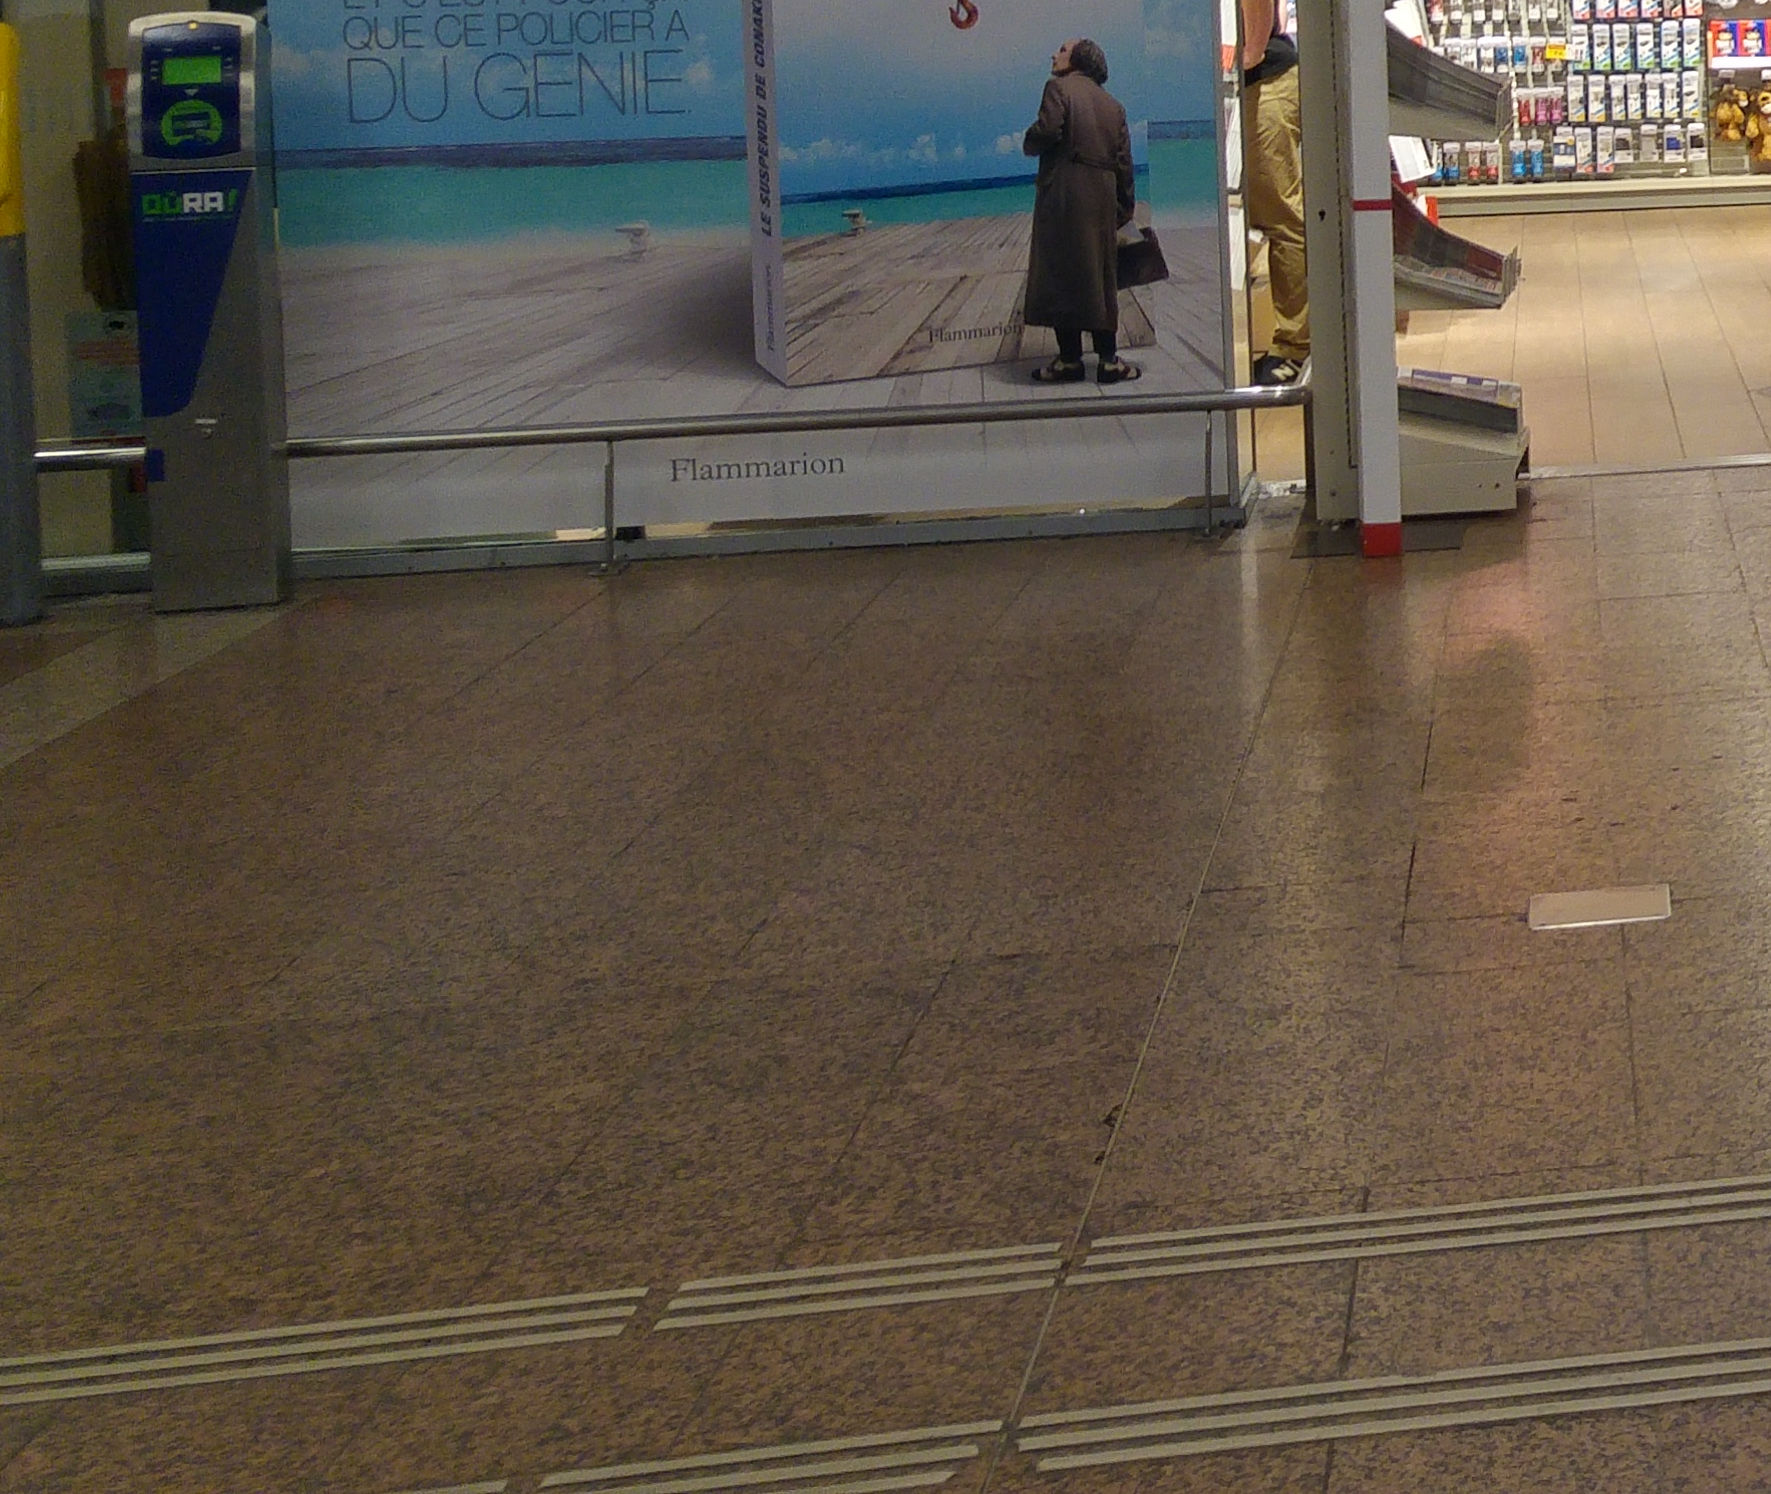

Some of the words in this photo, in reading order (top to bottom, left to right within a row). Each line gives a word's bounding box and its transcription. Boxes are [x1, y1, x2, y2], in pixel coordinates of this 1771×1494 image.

[343, 14, 425, 51] QUE
[434, 13, 487, 49] CE
[496, 9, 655, 46] POLICIER
[664, 9, 690, 43] A
[347, 55, 448, 124] DU
[756, 105, 772, 208] SUSPENDU
[928, 321, 1025, 344] Flammarion
[669, 452, 846, 483] Flammarion
